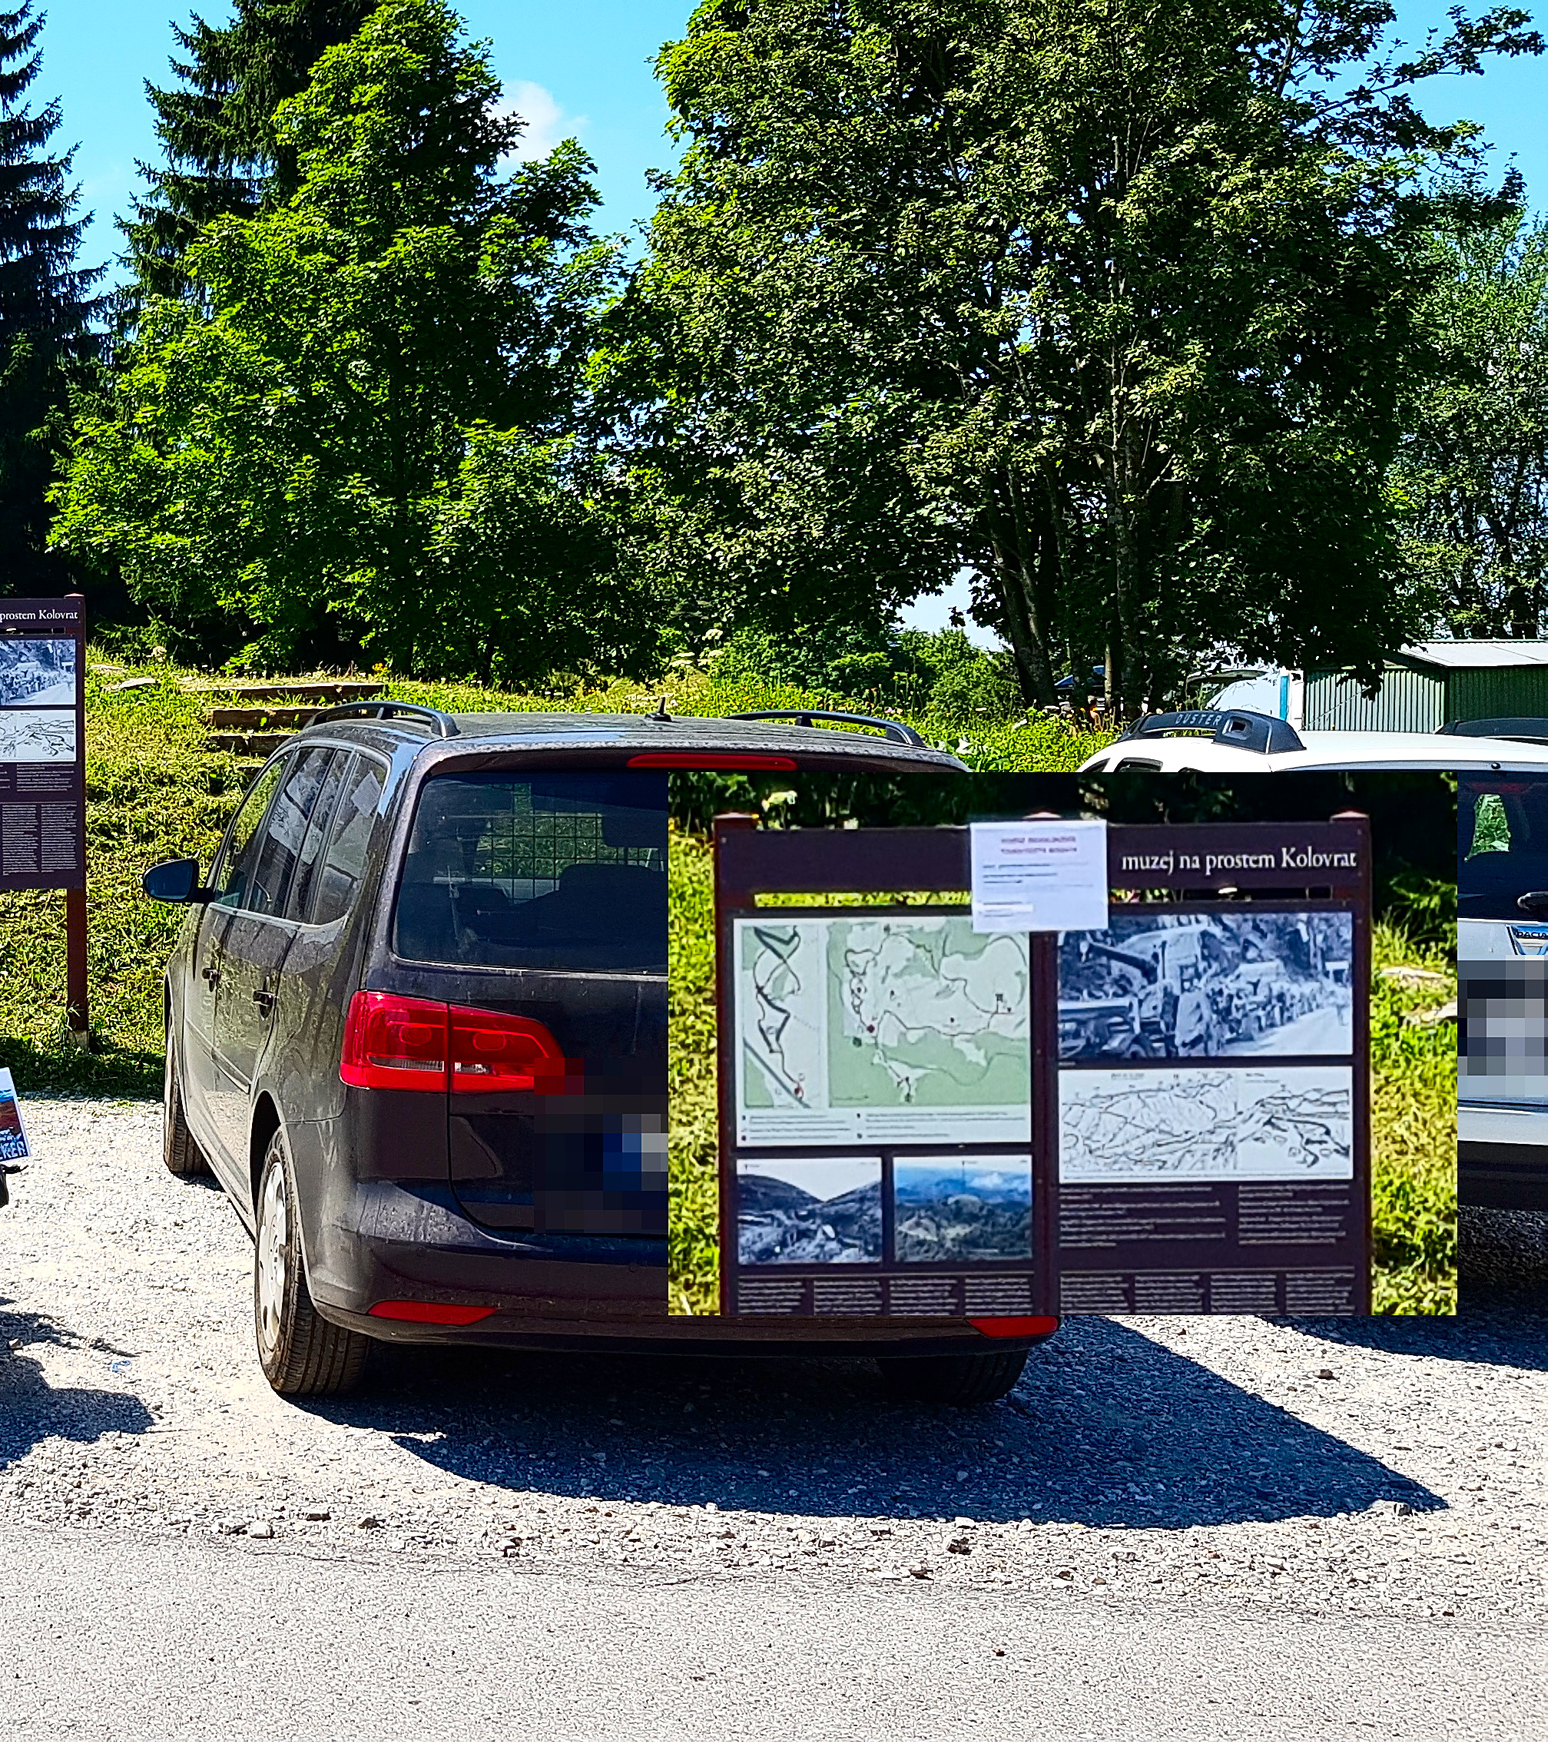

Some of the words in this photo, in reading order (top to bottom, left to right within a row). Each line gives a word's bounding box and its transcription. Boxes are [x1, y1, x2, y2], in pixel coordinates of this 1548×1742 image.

[0, 611, 36, 623] prostem
[38, 609, 79, 621] Kolovrat
[1175, 713, 1222, 726] DUSTER
[1122, 849, 1174, 875] muzej
[1179, 853, 1200, 871] na
[1205, 850, 1276, 875] prostem
[1281, 846, 1357, 870] Kolovrat
[1516, 931, 1548, 939] DACIA
